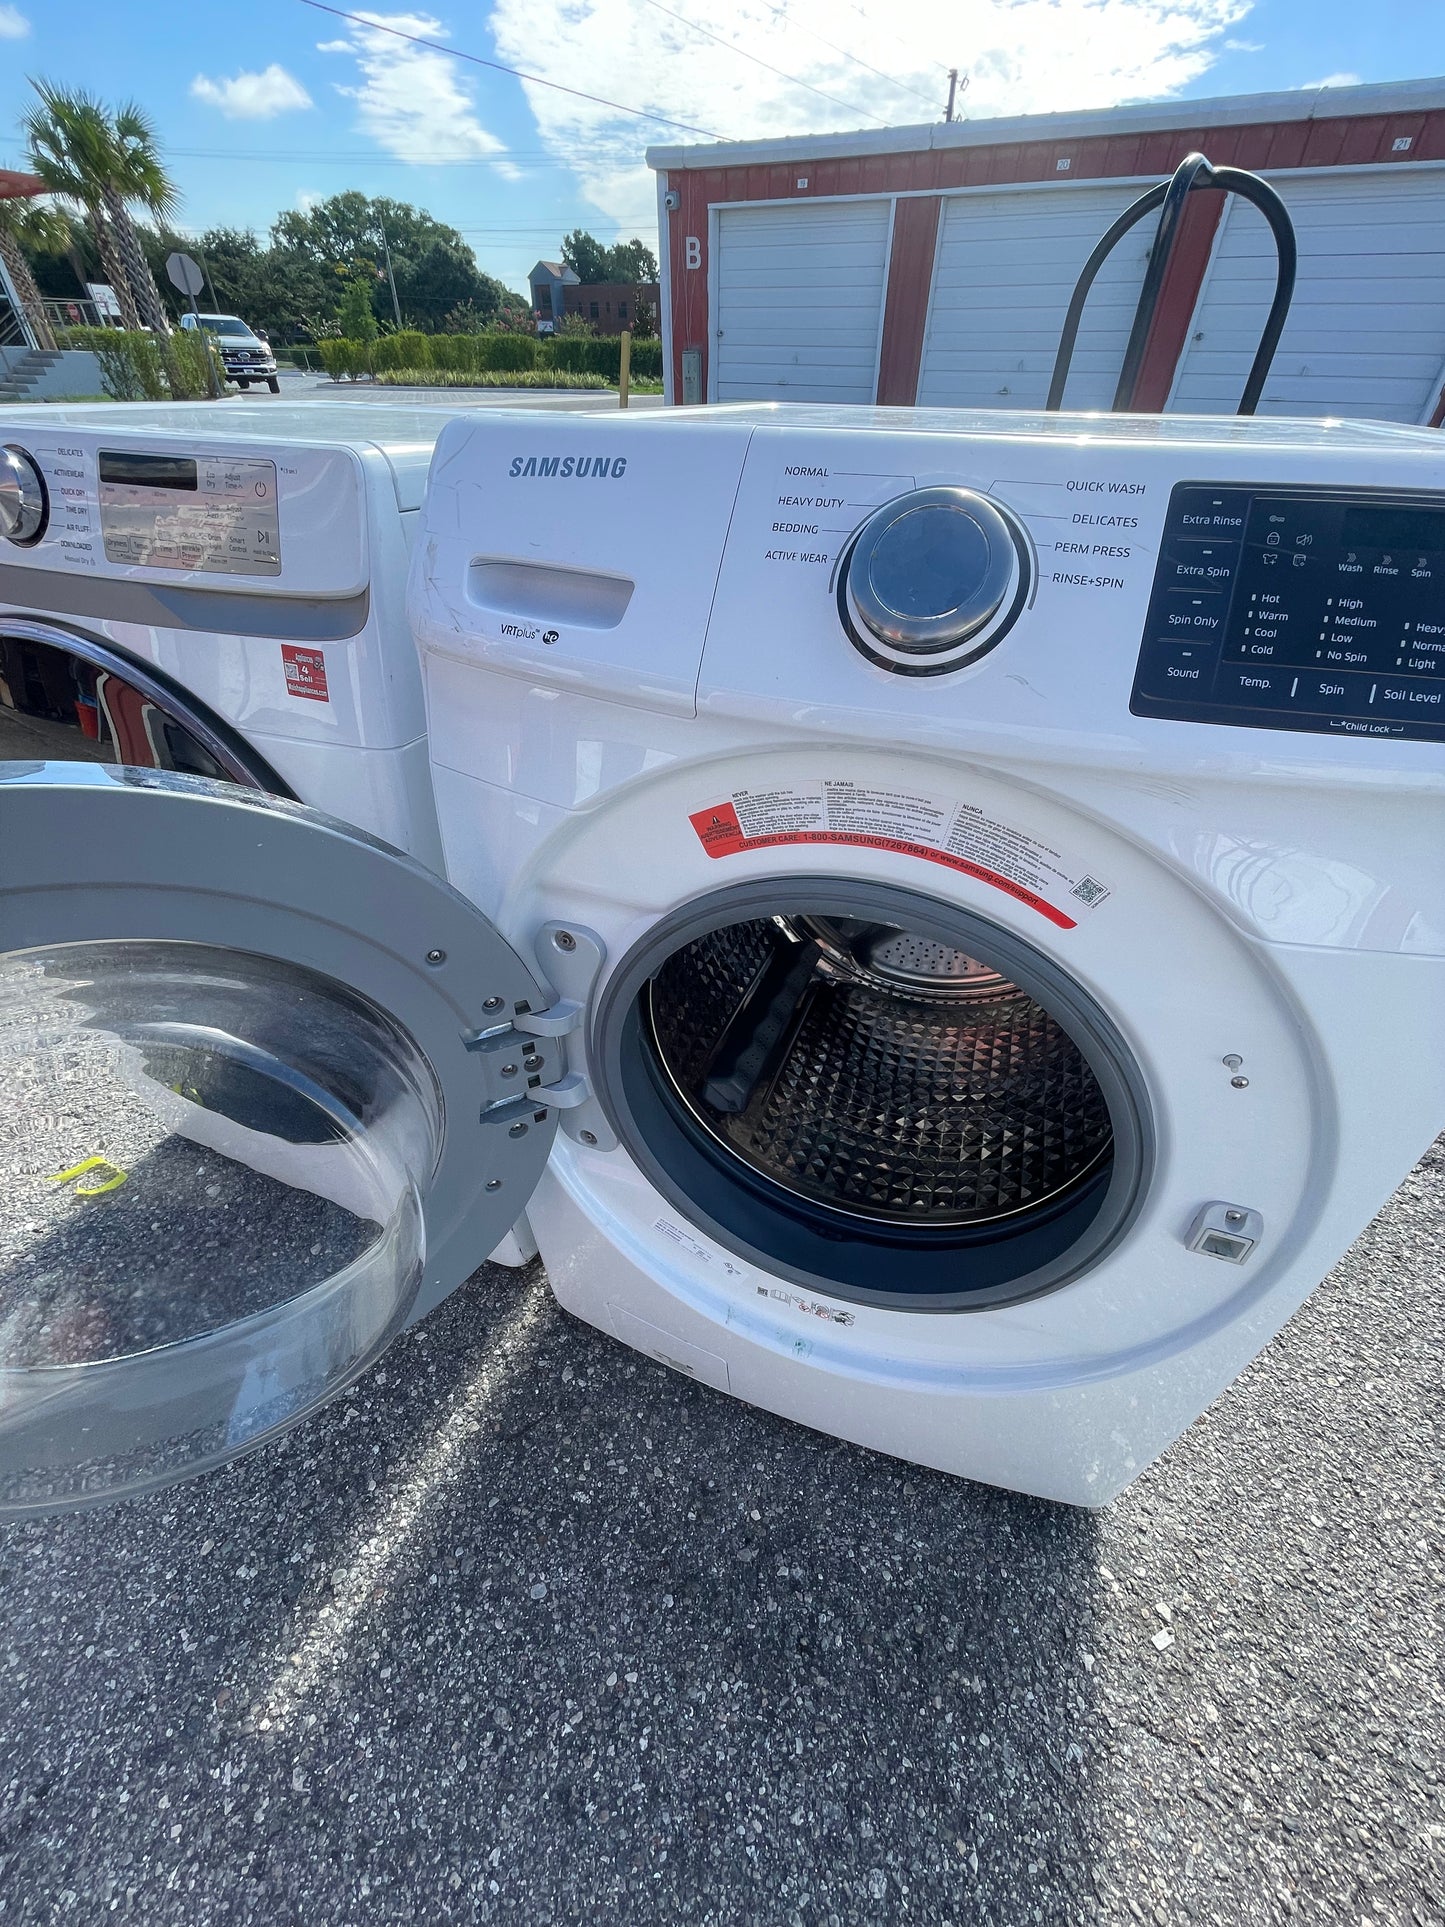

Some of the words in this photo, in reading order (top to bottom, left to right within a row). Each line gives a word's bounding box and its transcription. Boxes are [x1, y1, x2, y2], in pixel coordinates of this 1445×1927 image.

[686, 236, 702, 270] B
[57, 448, 83, 457] DELICATES
[54, 469, 84, 478] ACTIVEWEAR
[509, 457, 627, 478] SAMSUNG
[784, 466, 830, 477] NORMAL
[224, 473, 240, 482] Adjust
[60, 487, 76, 496] QUICK
[1065, 480, 1104, 493] QUICK
[1105, 482, 1146, 495] WASH
[778, 496, 813, 508] HEAVY
[815, 498, 844, 508] DUTY
[1072, 514, 1138, 528] DELICATES
[1182, 514, 1210, 526] Extra
[1213, 516, 1242, 526] Rinse
[772, 523, 819, 534] BEDDING
[1054, 542, 1089, 555] PERM
[1092, 544, 1130, 558] PRESS
[765, 551, 797, 562] ACTIVE
[799, 552, 828, 564] WEAR
[1176, 564, 1204, 576] Extra
[1206, 566, 1230, 578] Spin
[1338, 564, 1363, 572] Wash
[1374, 566, 1399, 575] Rinse
[1411, 568, 1431, 578] Spin
[1052, 572, 1124, 588] RINSE+SPIN
[1262, 594, 1280, 604] Hot
[1338, 598, 1364, 610] High
[1169, 614, 1191, 626] Spin
[1194, 616, 1218, 628] Only
[1258, 612, 1289, 621] Warm
[1334, 616, 1377, 628] Medium
[1254, 628, 1277, 638] Cool
[1331, 634, 1353, 644] Low
[1251, 644, 1274, 655] Cold
[1412, 640, 1445, 652] Norma
[1327, 651, 1342, 660] No
[1344, 652, 1368, 663] Spin
[301, 666, 309, 674] 4
[1408, 658, 1436, 670] Light
[1167, 666, 1200, 678] Sound
[1239, 676, 1272, 690] Temp.
[1319, 684, 1344, 696] Spin
[1384, 689, 1406, 701] Soil
[1409, 690, 1441, 704] Level
[1369, 724, 1390, 734] Lock
[732, 790, 748, 798] NEVER
[962, 804, 984, 816] NUNCA
[739, 836, 777, 848] CUSTOMER
[803, 833, 928, 856] 1-800-SAMSUNG(7267864)
[930, 852, 940, 860] or
[940, 853, 1040, 905] www.samsung.com/support
